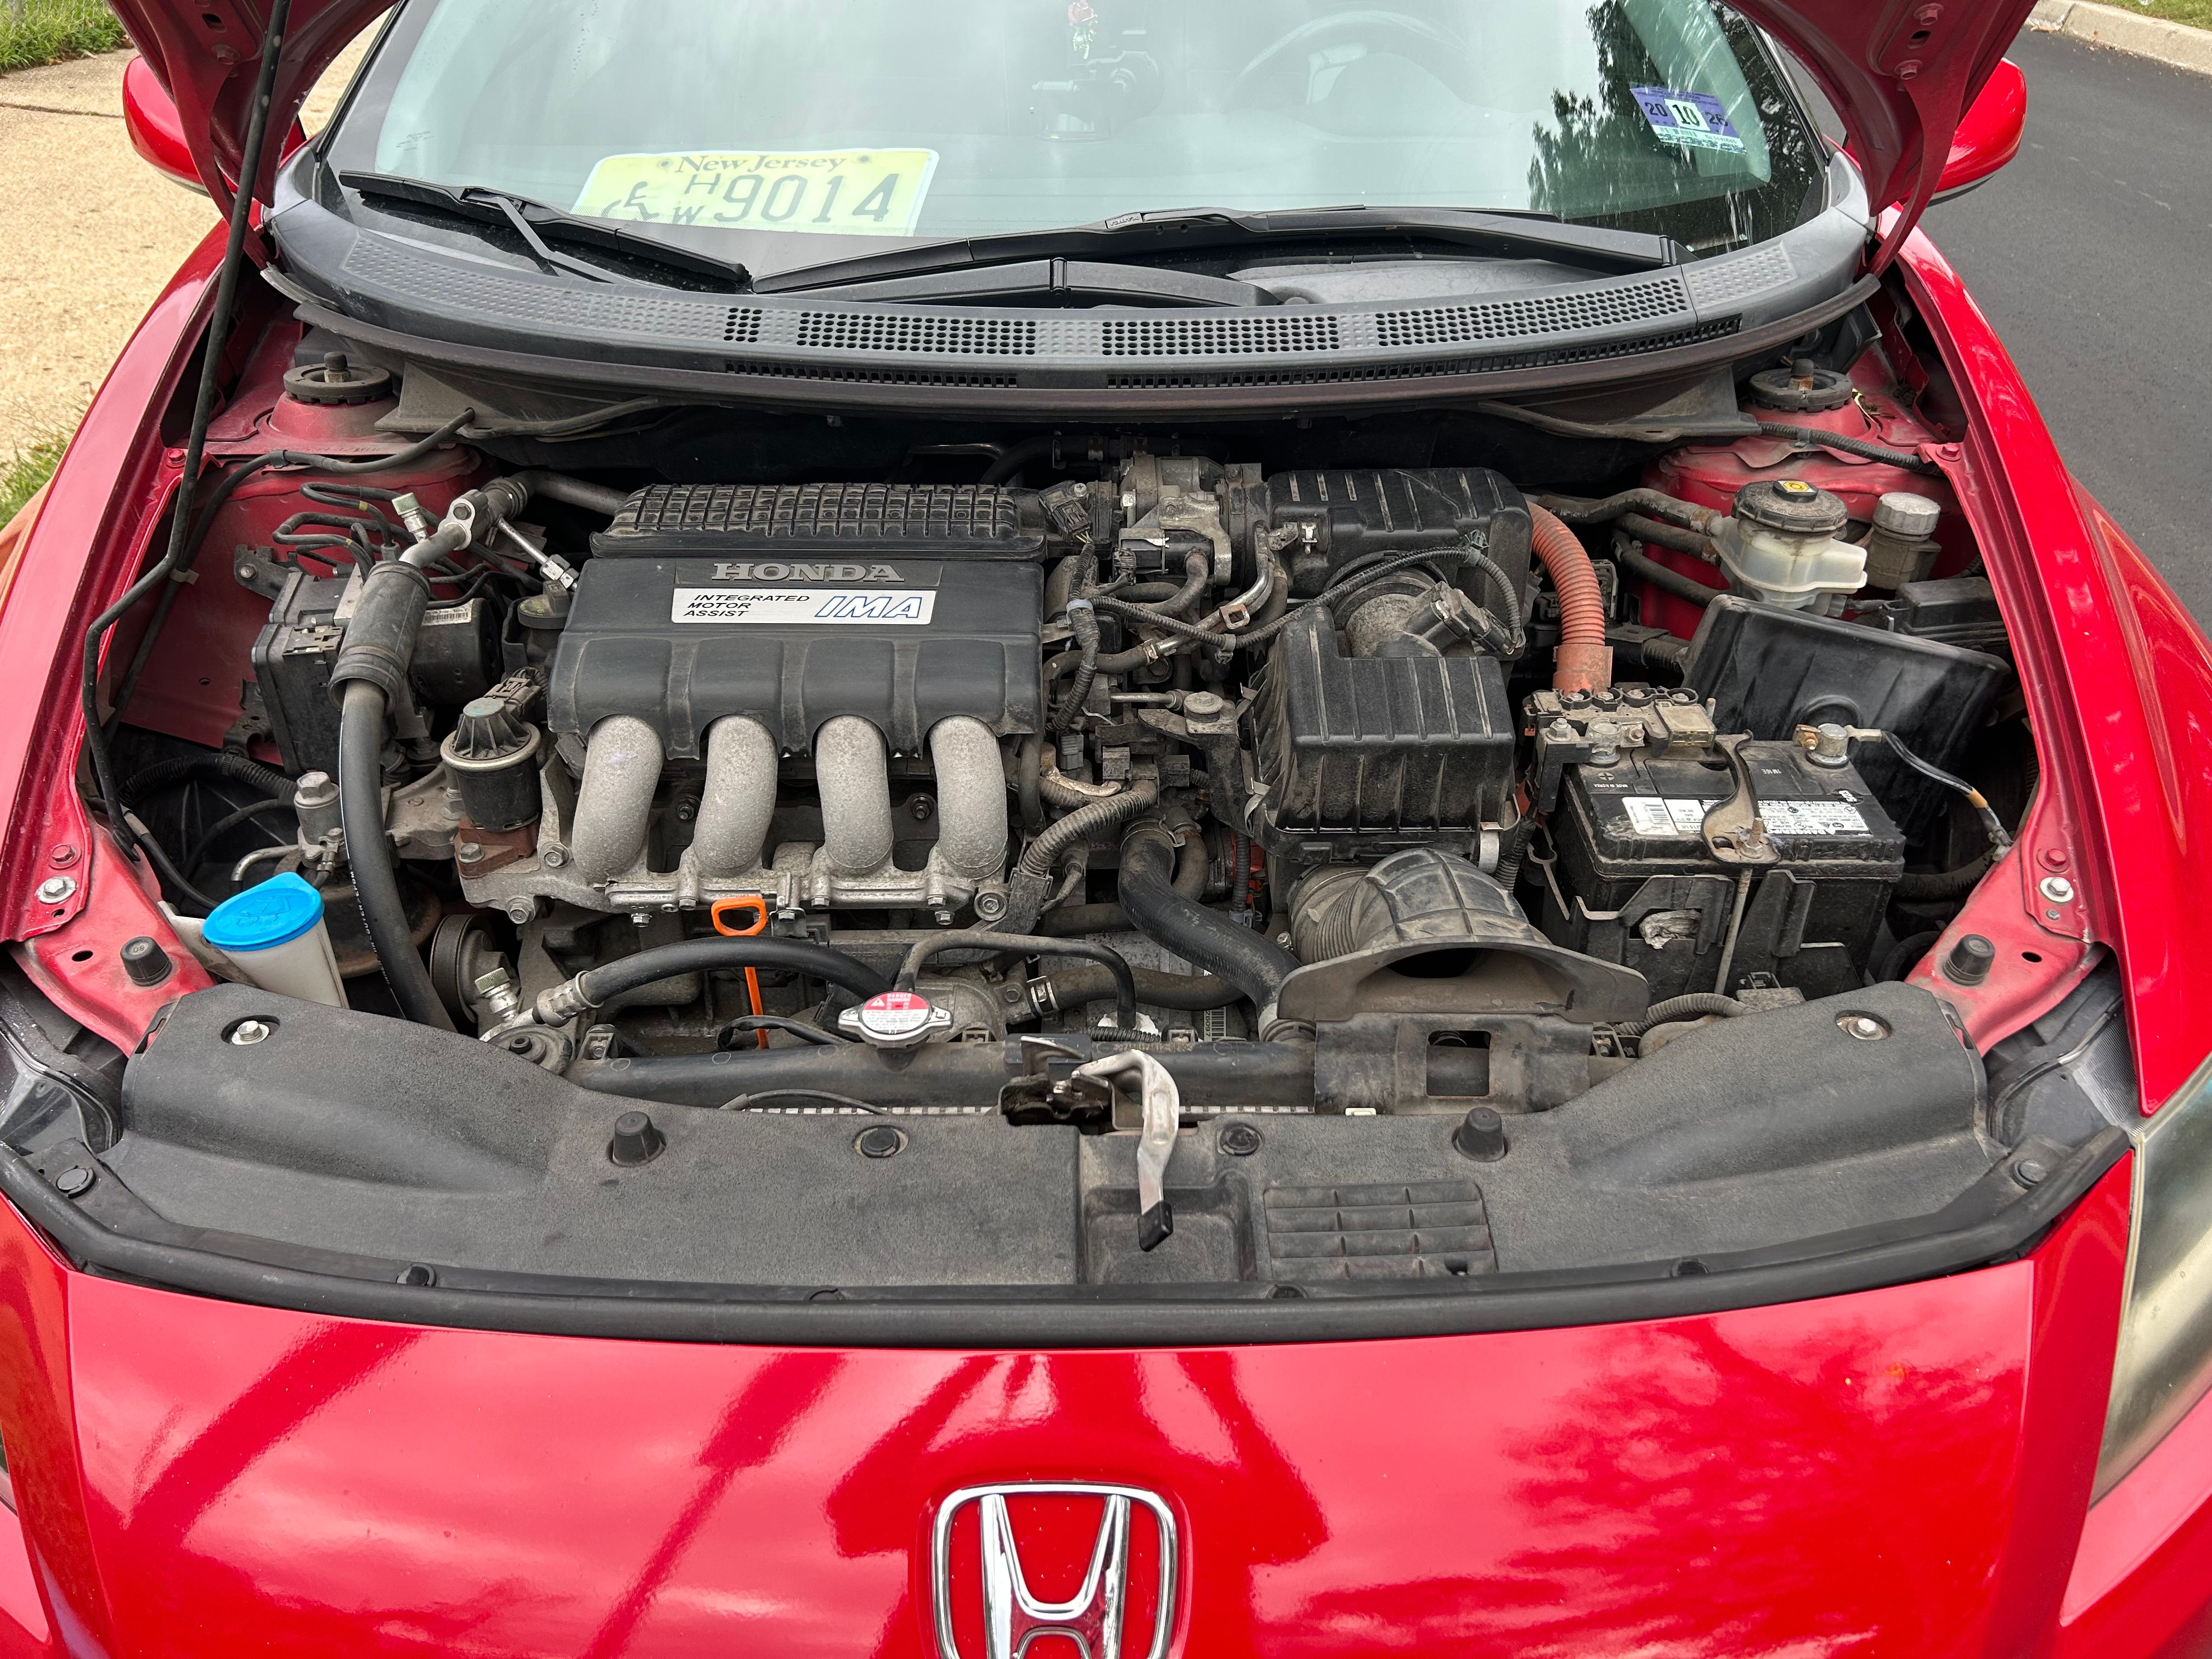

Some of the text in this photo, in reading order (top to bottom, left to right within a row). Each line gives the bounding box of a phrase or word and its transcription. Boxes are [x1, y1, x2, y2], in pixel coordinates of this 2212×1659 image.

[1644, 102, 1668, 117] 20
[1672, 104, 1700, 127] 10
[675, 155, 847, 173] New Jersey
[714, 173, 900, 222] 9014
[711, 562, 905, 583] HONDA
[814, 596, 923, 618] IMA
